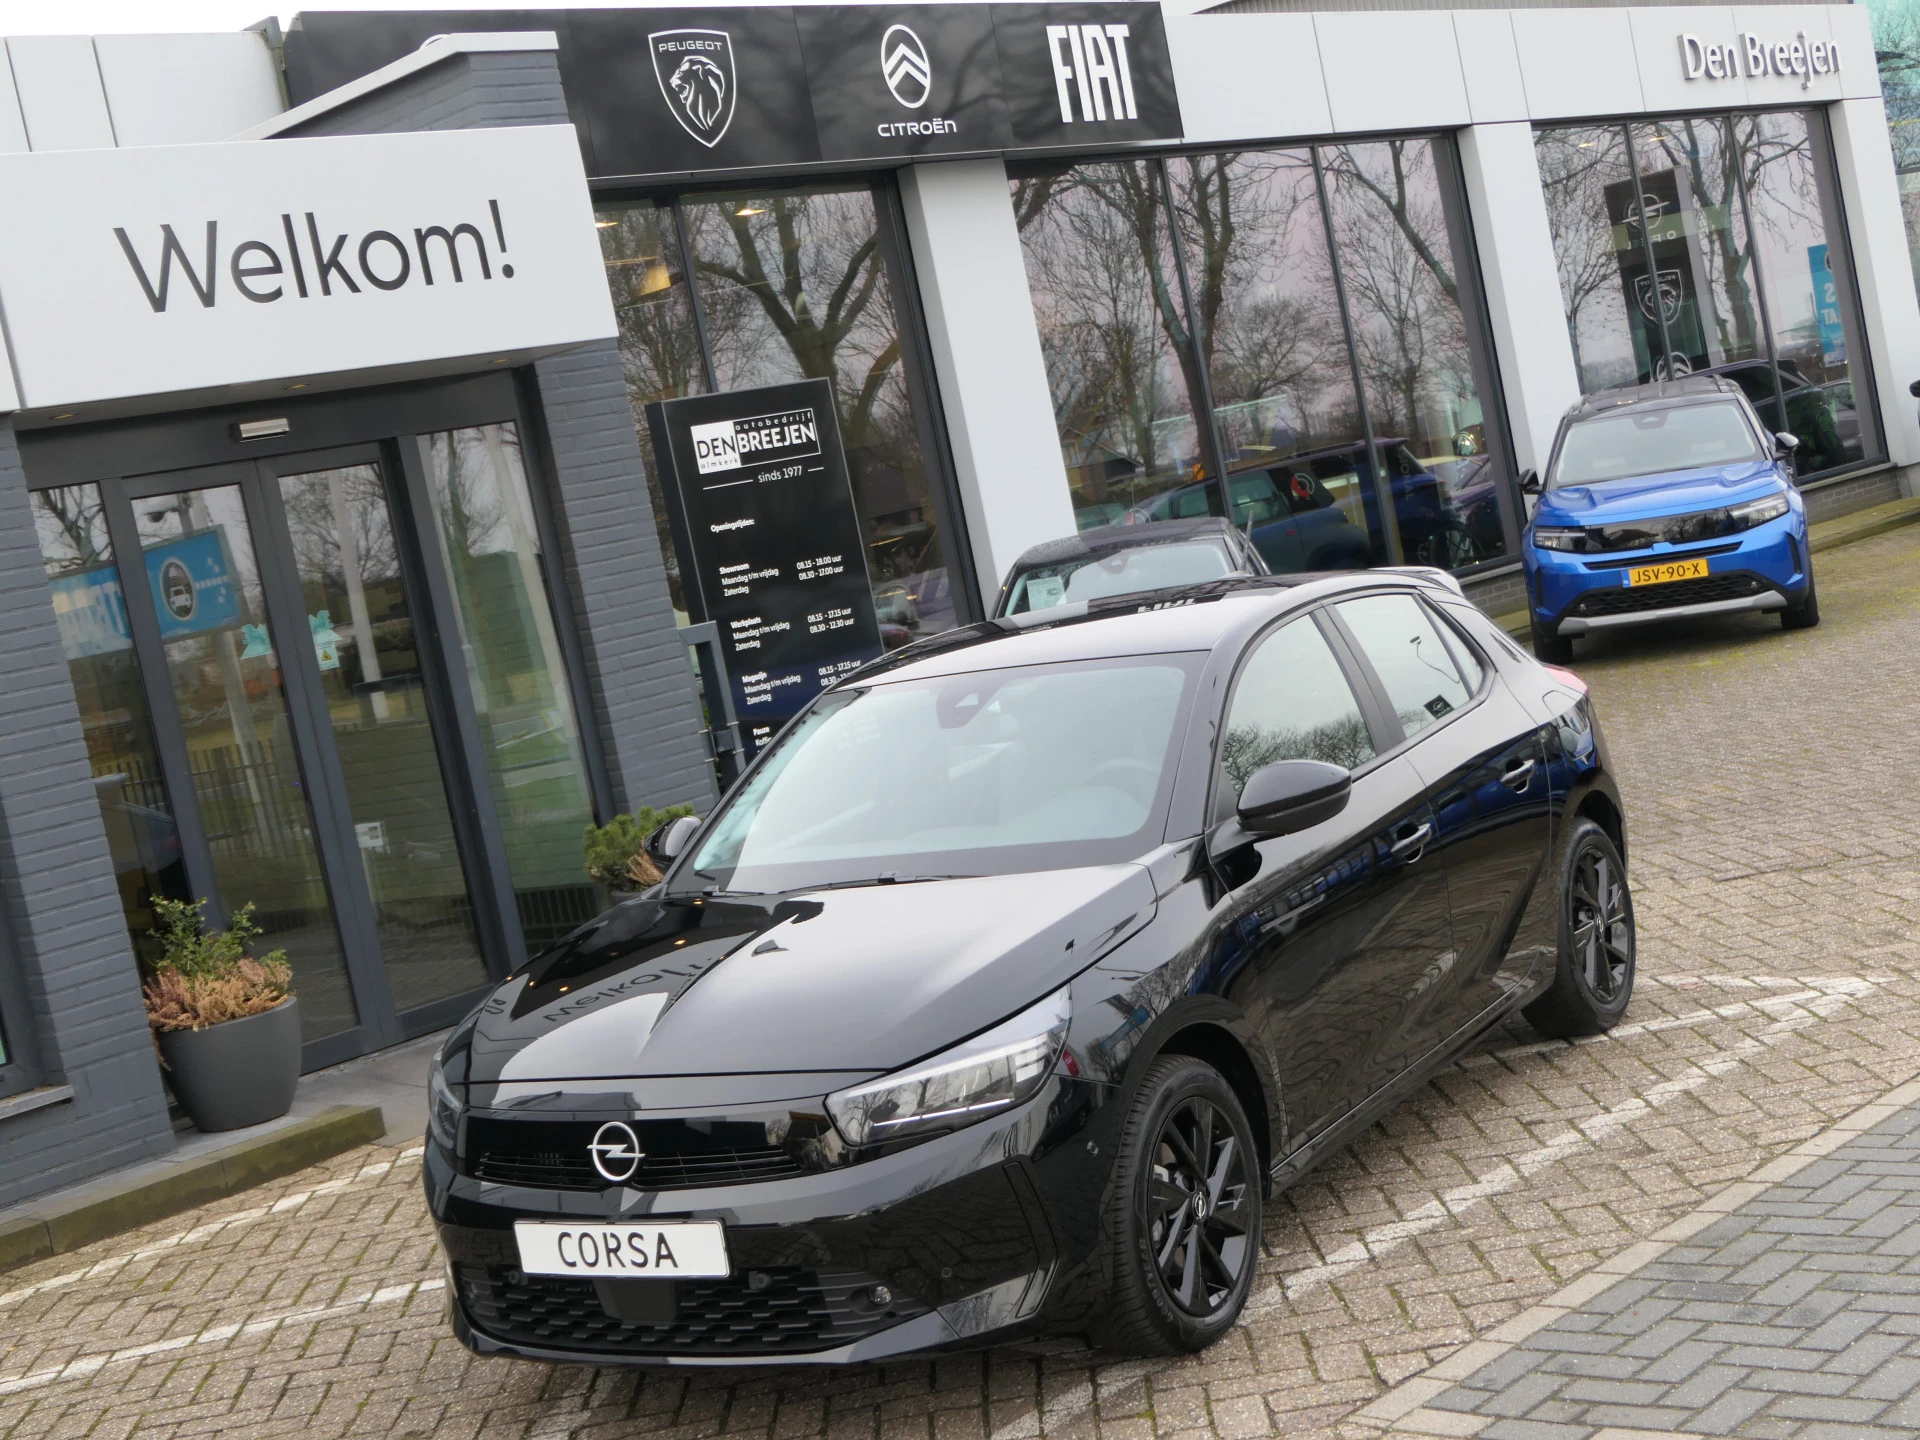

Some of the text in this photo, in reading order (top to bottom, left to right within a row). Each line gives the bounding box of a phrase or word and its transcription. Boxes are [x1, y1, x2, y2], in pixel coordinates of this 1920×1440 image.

[658, 40, 723, 53] PEUGEOT
[1678, 31, 1841, 90] Den Breejen
[1046, 25, 1138, 123] FIAT
[112, 198, 515, 314] Welkom!
[735, 412, 811, 431] autobedrijf
[696, 422, 816, 459] DEN BREEJEN
[700, 458, 739, 470] almkerk
[758, 465, 803, 483] sinds 1977
[719, 563, 750, 575] Showroom
[721, 574, 748, 586] Maandag
[748, 571, 759, 580] t/m
[759, 568, 780, 579] vrijdag
[832, 554, 842, 562] uur
[1634, 562, 1701, 583] JSV-90-X
[723, 585, 749, 597] Zaterdag
[833, 565, 844, 573] uur
[730, 616, 762, 629] Werkplaats
[732, 628, 760, 640] Maandag
[759, 625, 771, 635] t/m
[770, 621, 790, 632] vrijdag
[841, 607, 852, 615] uur
[735, 640, 761, 652] Zaterdag
[844, 618, 855, 626] uur
[741, 671, 767, 684] Magazijn
[744, 682, 771, 694] Maandag
[770, 678, 782, 688] t/m
[781, 674, 802, 685] vrijdag
[746, 693, 772, 705] Zaterdag
[752, 726, 770, 736] Pauze
[557, 1231, 679, 1268] CORSA
